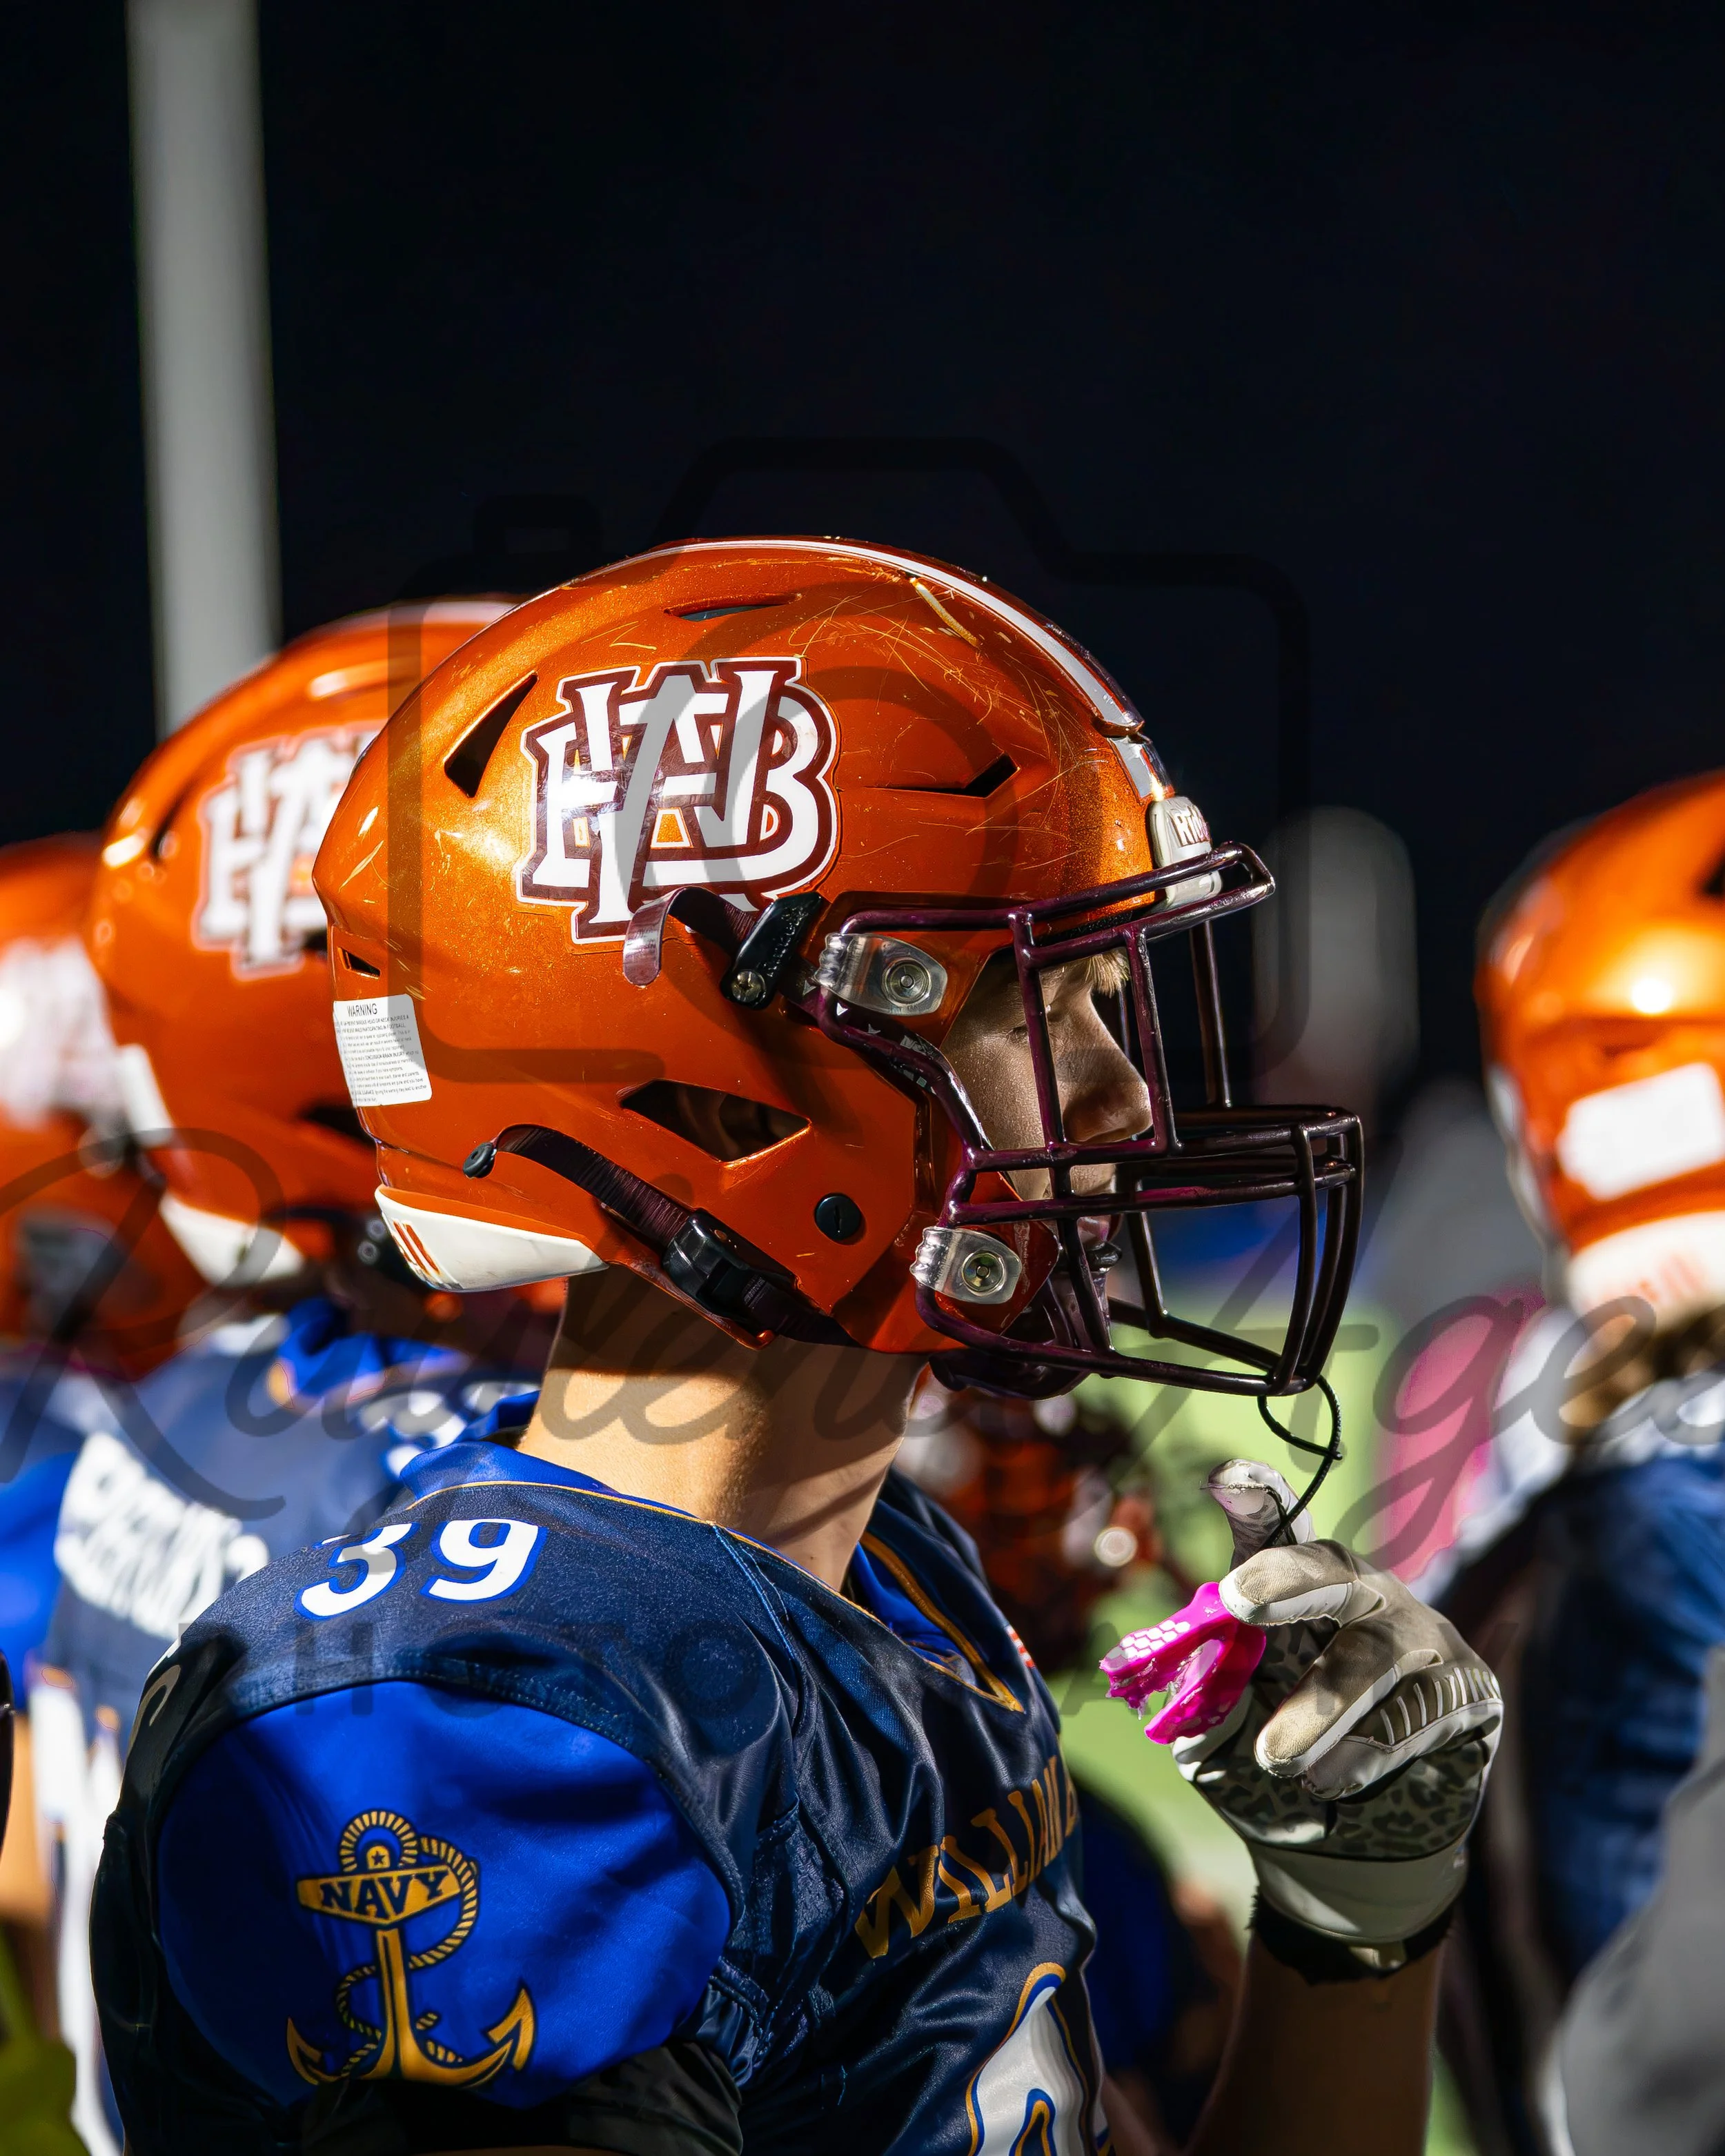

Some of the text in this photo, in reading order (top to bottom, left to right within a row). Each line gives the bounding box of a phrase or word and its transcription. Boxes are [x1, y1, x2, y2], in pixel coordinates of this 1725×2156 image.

[347, 1002, 377, 1017] WARNING
[295, 1517, 547, 1620] 39
[319, 1868, 449, 1920] NAVY
